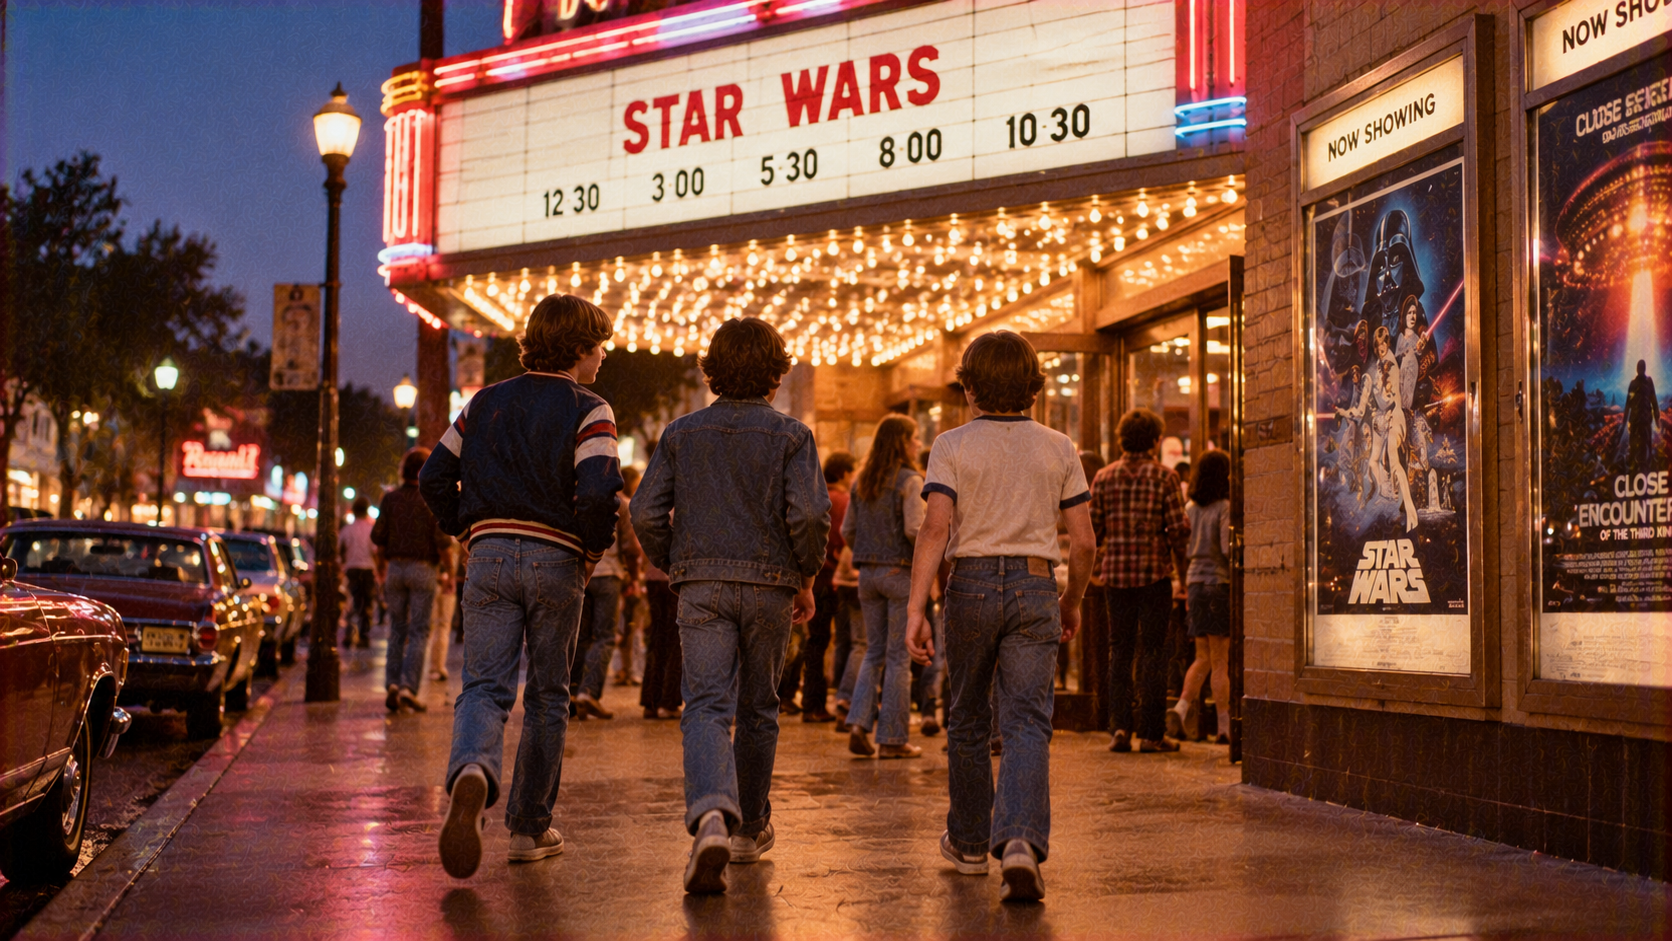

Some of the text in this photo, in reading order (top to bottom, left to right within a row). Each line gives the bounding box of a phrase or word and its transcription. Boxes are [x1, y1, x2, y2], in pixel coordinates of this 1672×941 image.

[1562, 0, 1672, 54] NOW SHO
[623, 44, 941, 154] STAR WARS
[1328, 93, 1436, 162] NOW SHOWING
[1614, 470, 1669, 498] CLOSE
[1600, 529, 1611, 541] OF
[1612, 528, 1628, 540] THE
[1630, 526, 1655, 540] THIRD
[1356, 538, 1421, 570] STAR
[1347, 568, 1432, 604] WARS
